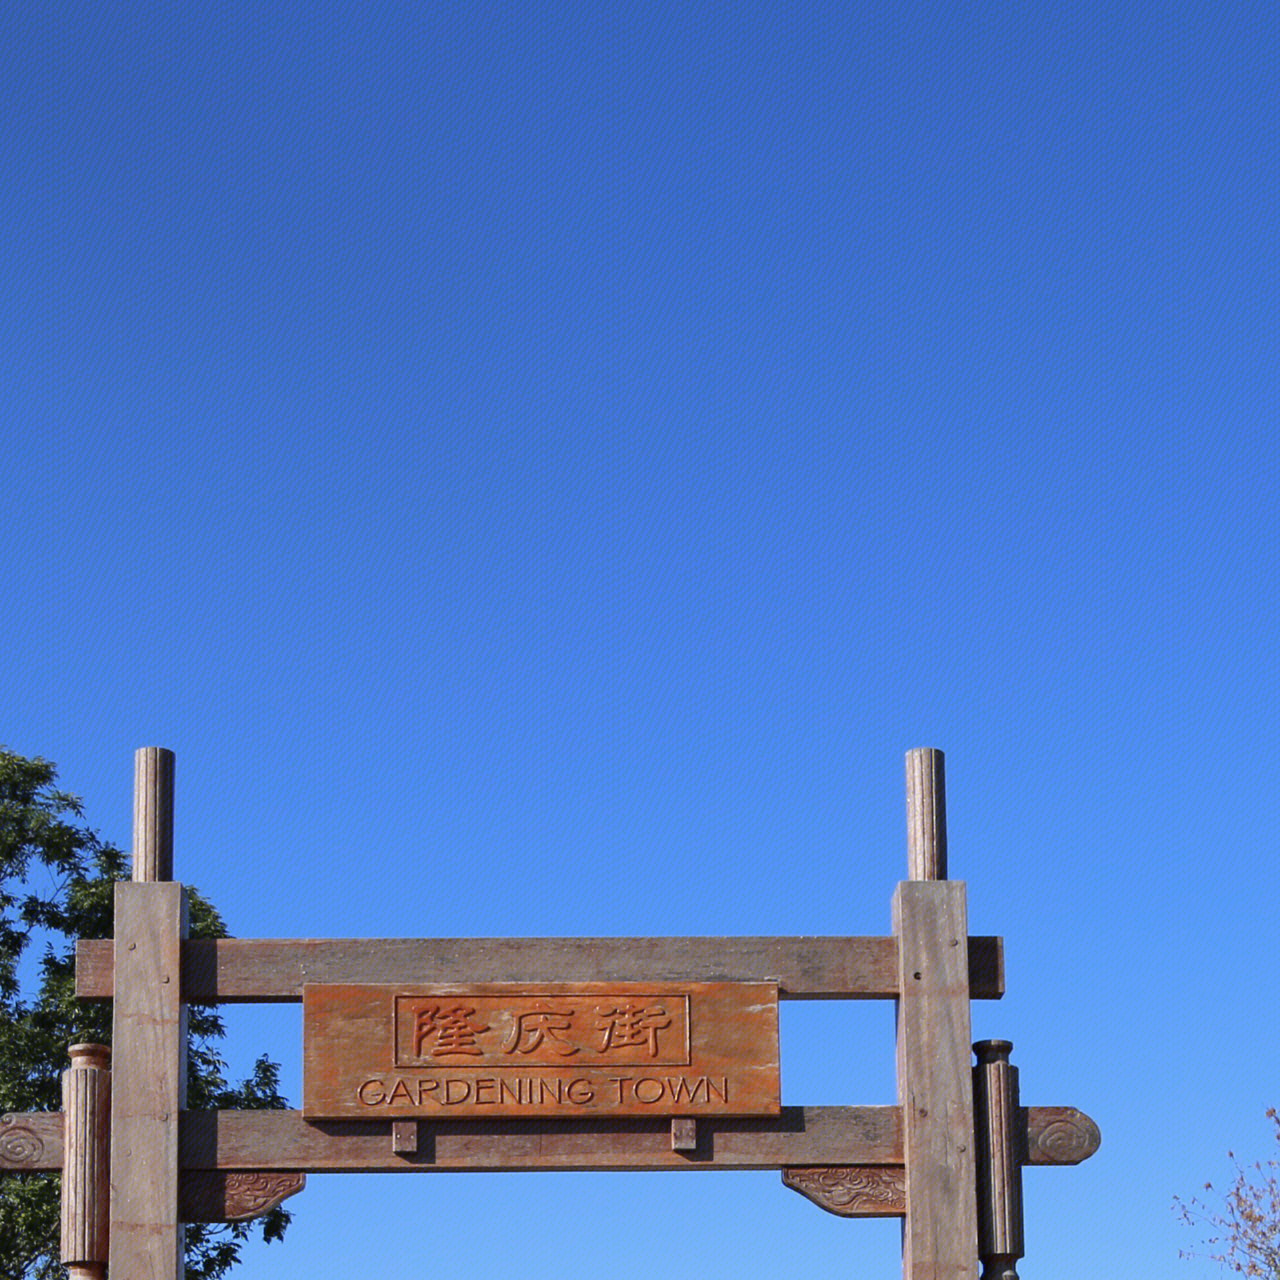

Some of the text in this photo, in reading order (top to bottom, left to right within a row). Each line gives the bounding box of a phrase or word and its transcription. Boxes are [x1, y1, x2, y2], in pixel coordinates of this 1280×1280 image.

[410, 1003, 673, 1058] 隆庆街
[357, 1075, 730, 1107] GARDENING TOWN
